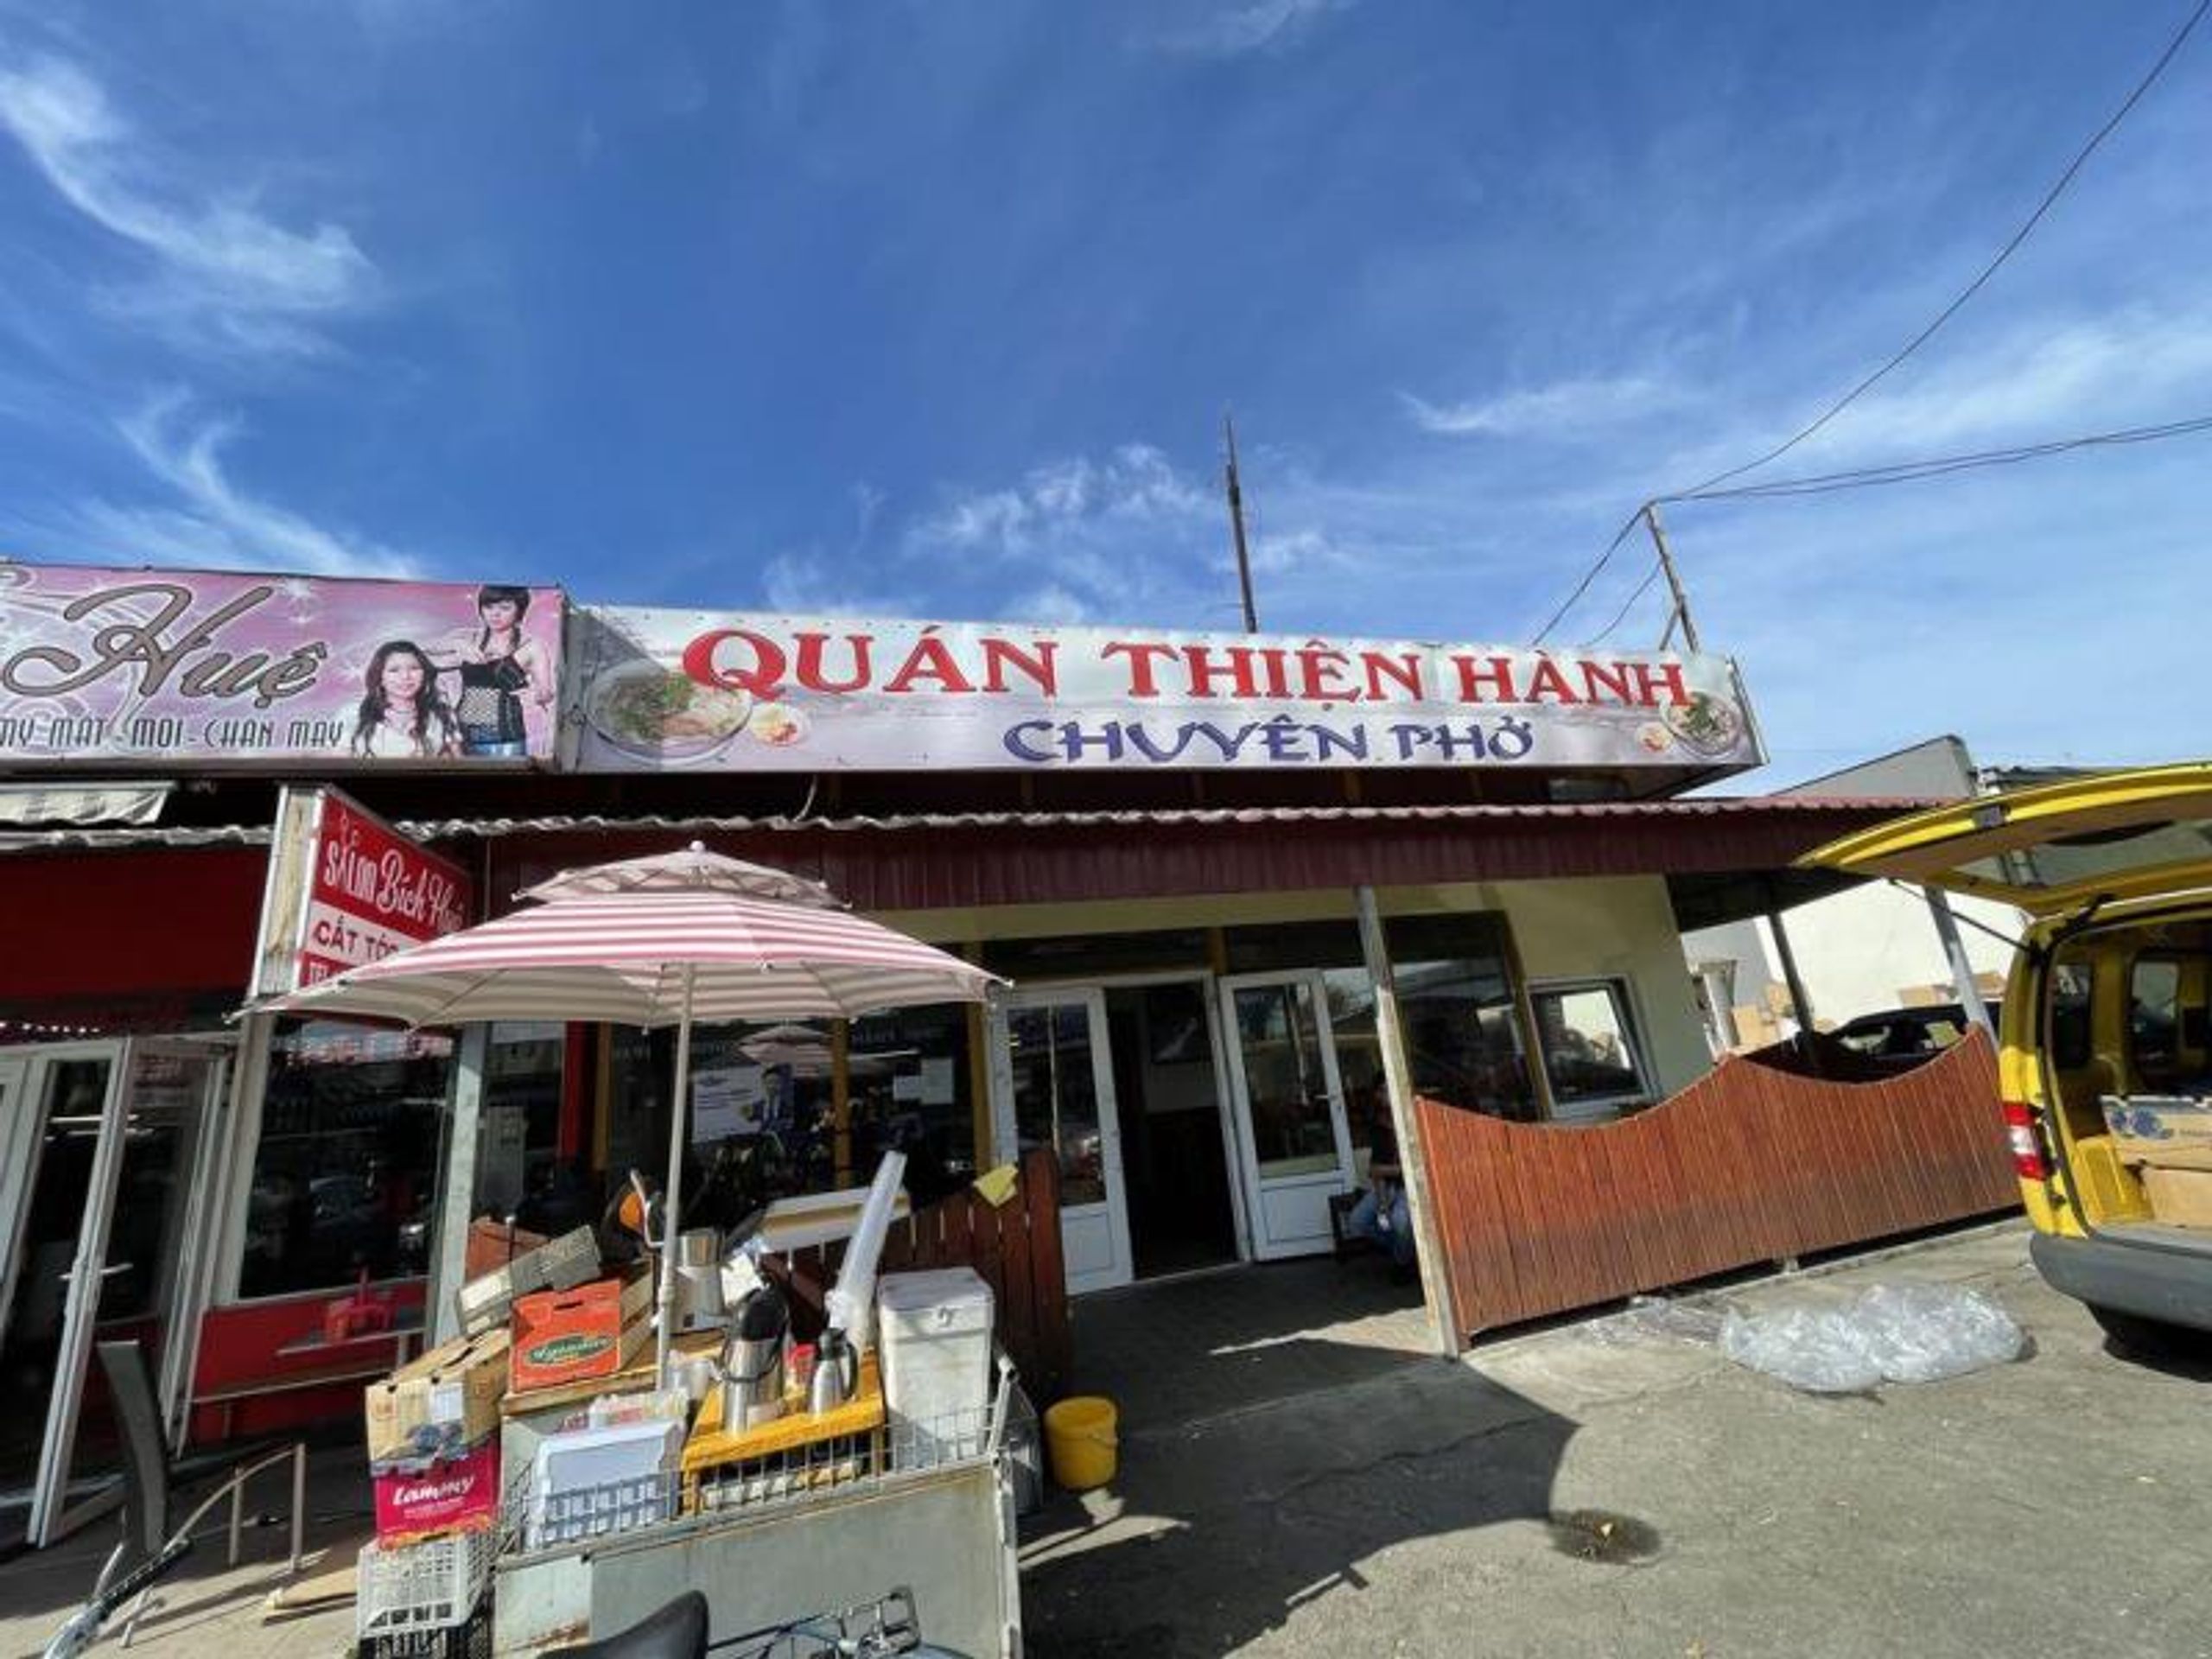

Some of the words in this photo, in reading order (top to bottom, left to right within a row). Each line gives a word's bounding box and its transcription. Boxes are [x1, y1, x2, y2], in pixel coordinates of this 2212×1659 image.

[3, 583, 327, 708] Huệ
[682, 626, 1058, 698] QUÁN
[1100, 641, 1422, 710] THIỆN
[1450, 651, 1690, 707] HÀNH
[1003, 714, 1368, 762] CHUYÊN
[1388, 715, 1533, 760] PHỞ
